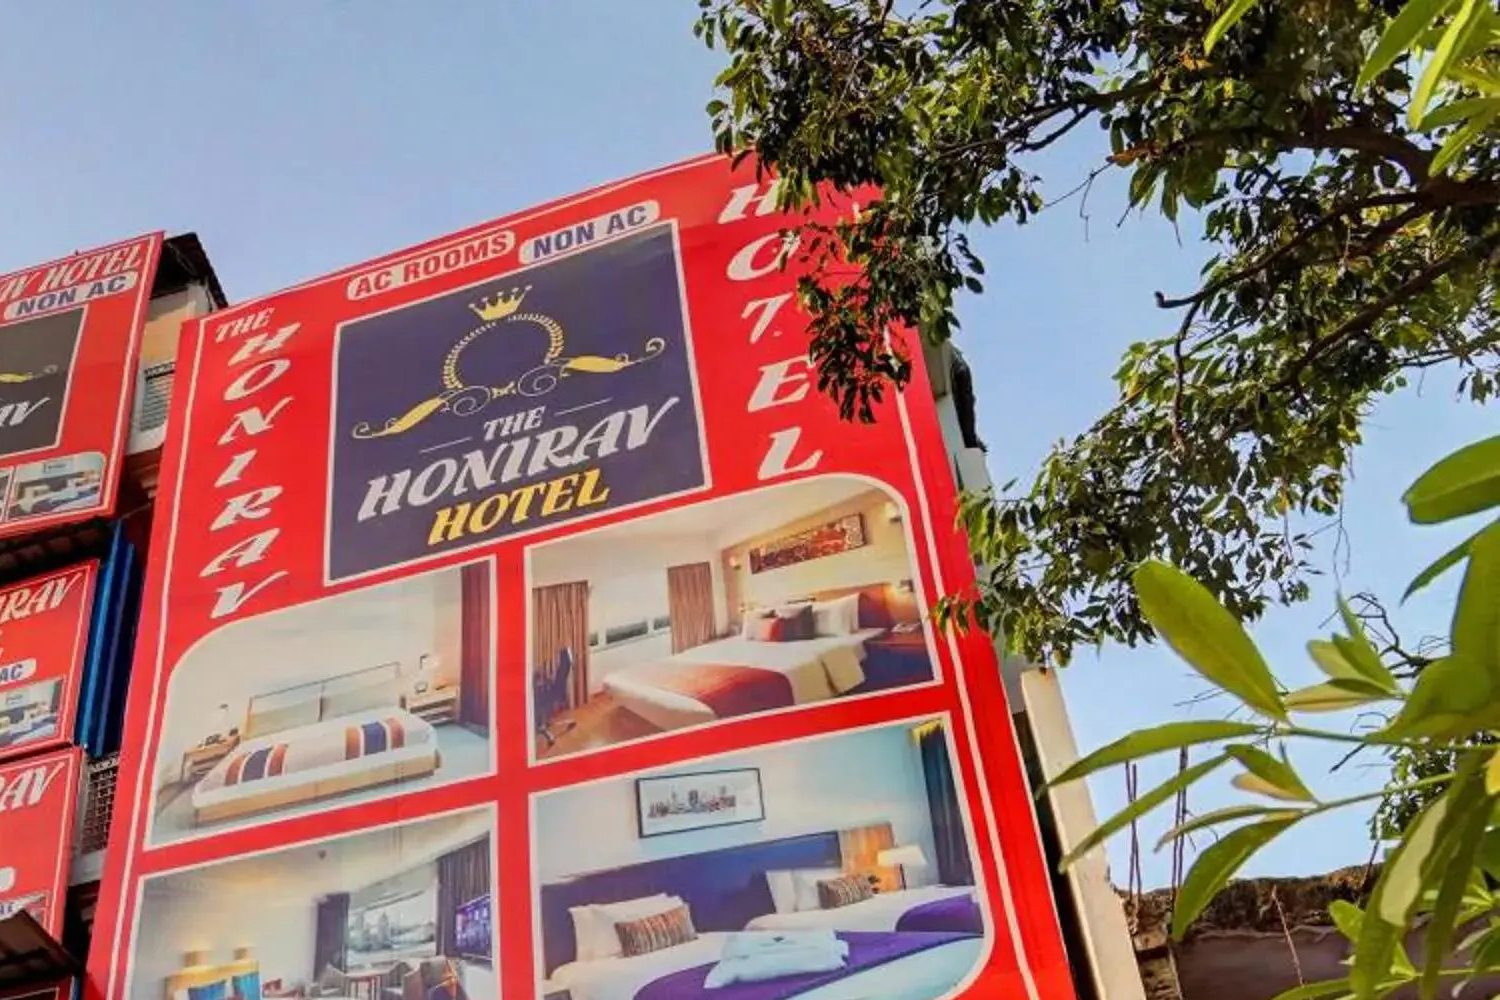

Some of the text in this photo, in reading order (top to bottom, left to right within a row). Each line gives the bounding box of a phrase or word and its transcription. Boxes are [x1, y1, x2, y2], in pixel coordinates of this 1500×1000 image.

[39, 246, 141, 292] HOTEL
[355, 205, 649, 298] AC ROOMS NON AC
[16, 275, 126, 314] NON AC
[215, 308, 275, 338] THE
[483, 405, 545, 443] THE
[199, 322, 302, 620] HONIRAV
[356, 397, 680, 524] HONIRAV
[427, 467, 612, 548] HOTEL
[0, 663, 21, 682] AC
